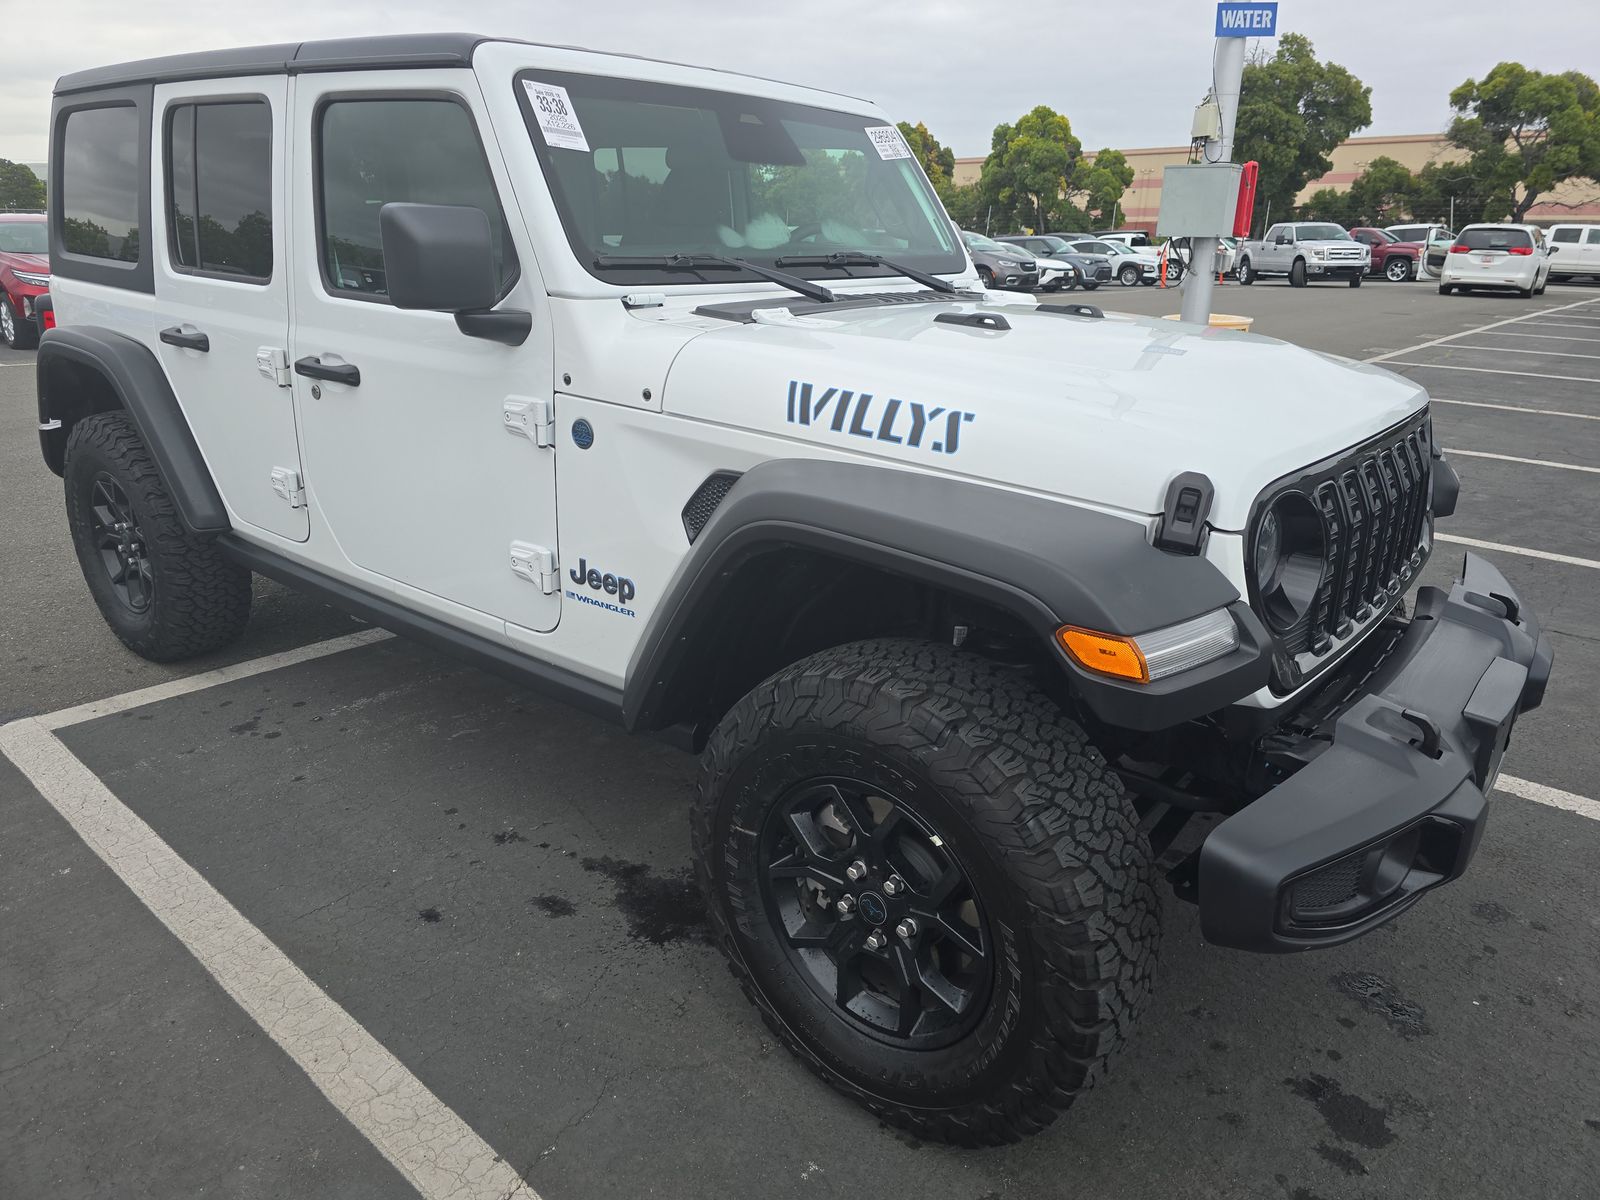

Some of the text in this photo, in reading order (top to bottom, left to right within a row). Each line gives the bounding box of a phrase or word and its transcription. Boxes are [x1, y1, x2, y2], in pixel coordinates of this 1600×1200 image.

[1222, 10, 1273, 29] WATER
[536, 95, 568, 116] 33:38
[786, 380, 976, 455] WILLYS
[569, 557, 636, 605] Jeep
[575, 593, 636, 618] WRANGLER
